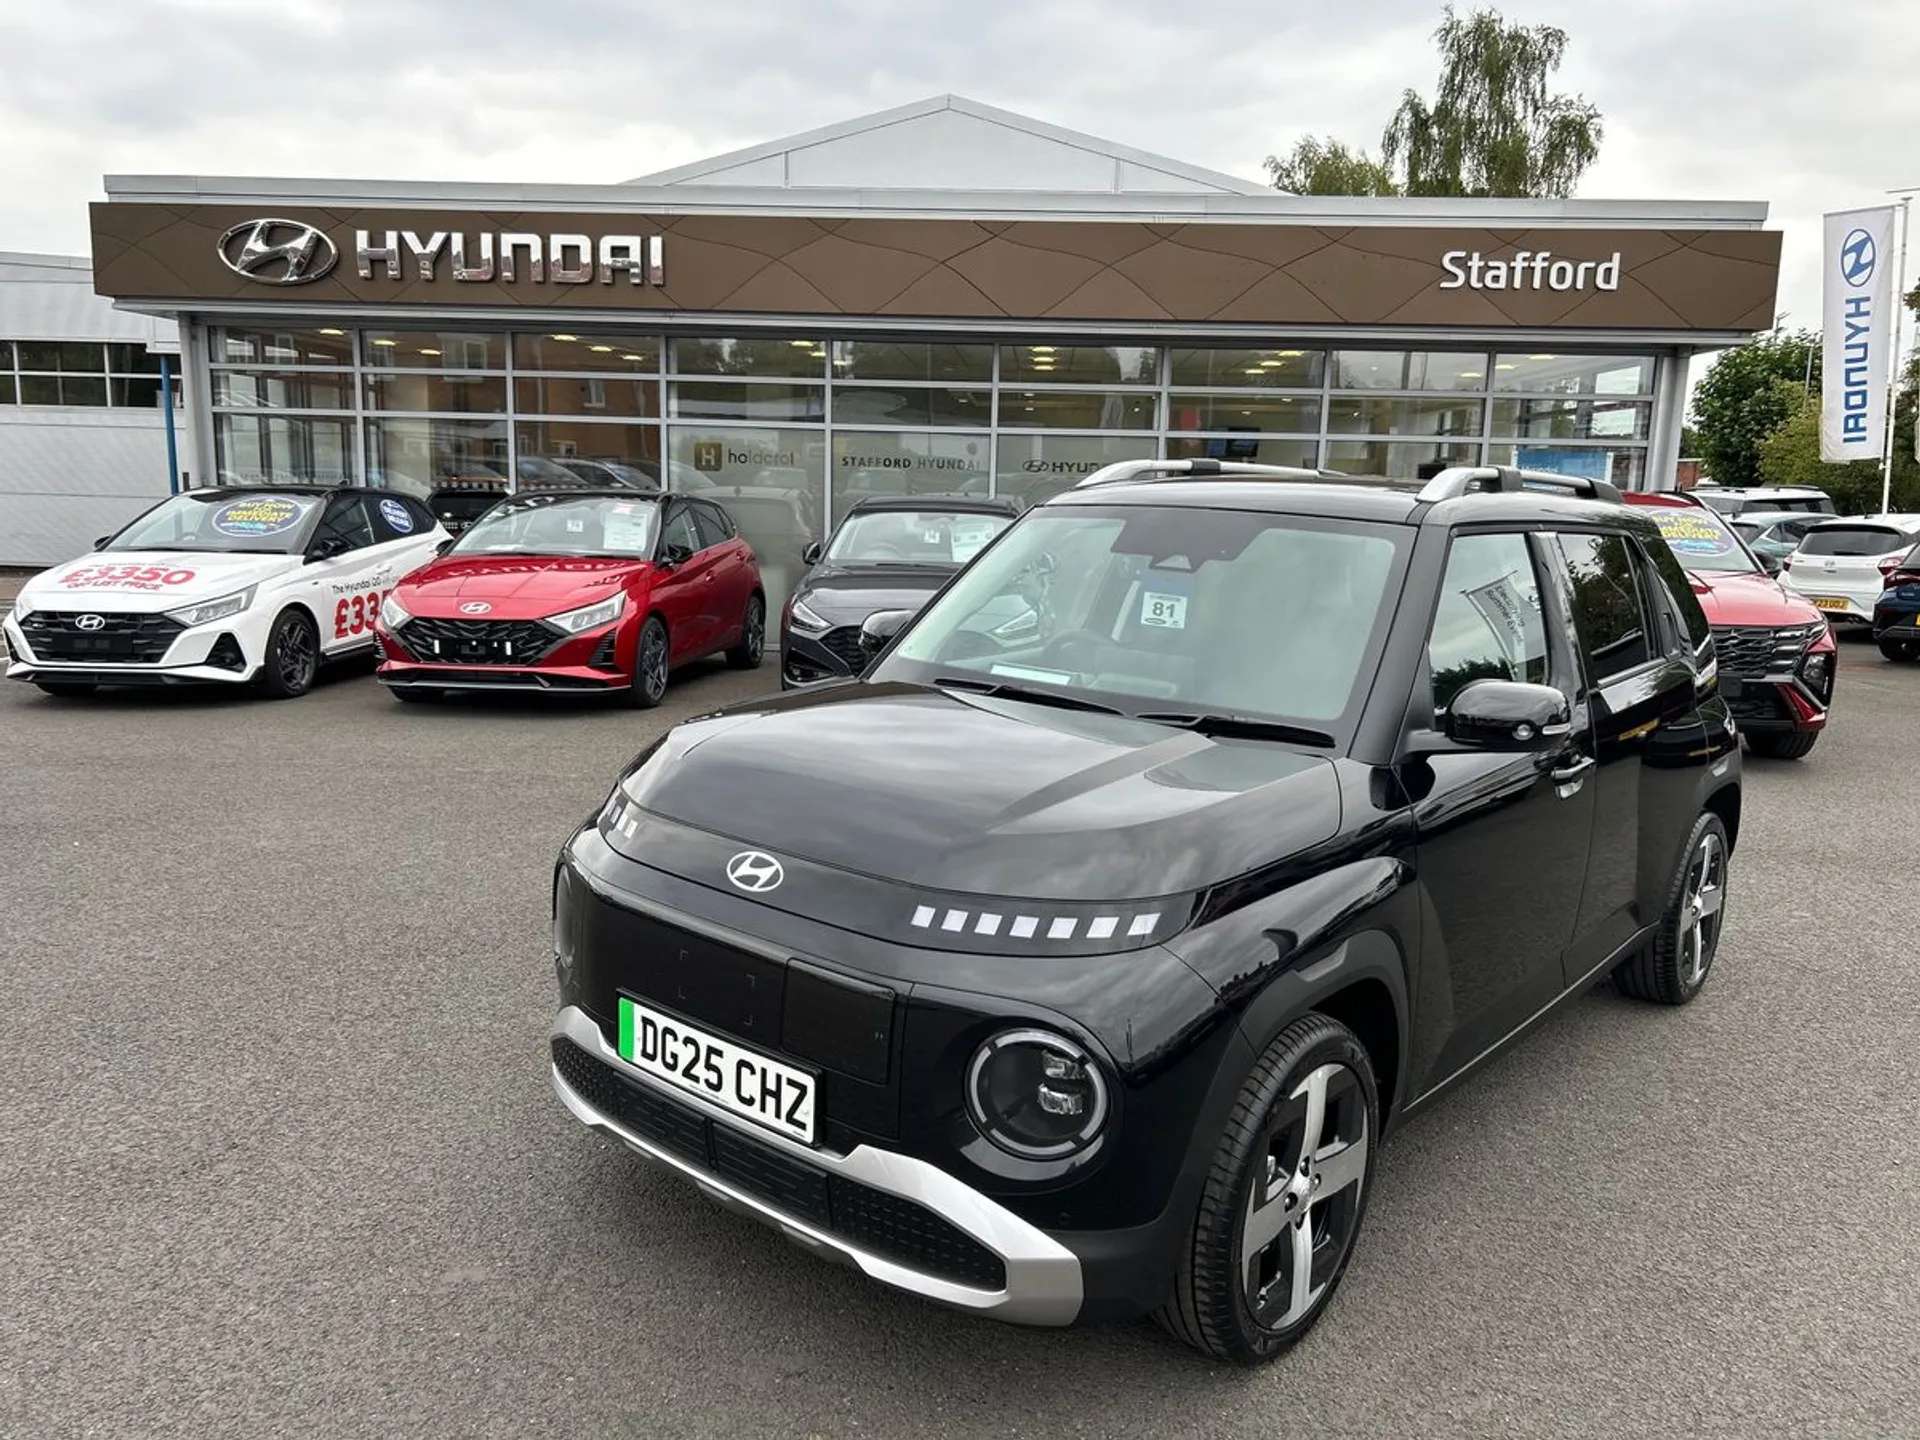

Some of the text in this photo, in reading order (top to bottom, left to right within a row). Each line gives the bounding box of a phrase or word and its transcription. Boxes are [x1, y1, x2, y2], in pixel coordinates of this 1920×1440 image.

[356, 229, 664, 287] HYUNDAI
[1440, 251, 1621, 290] Stafford
[1843, 296, 1871, 443] HYUNDAI
[841, 456, 981, 471] STAFFORD HYUNDAI
[58, 566, 195, 585] £3350
[335, 590, 392, 639] £33
[1152, 601, 1175, 618] 81
[641, 1016, 807, 1131] DG25 CHZ
